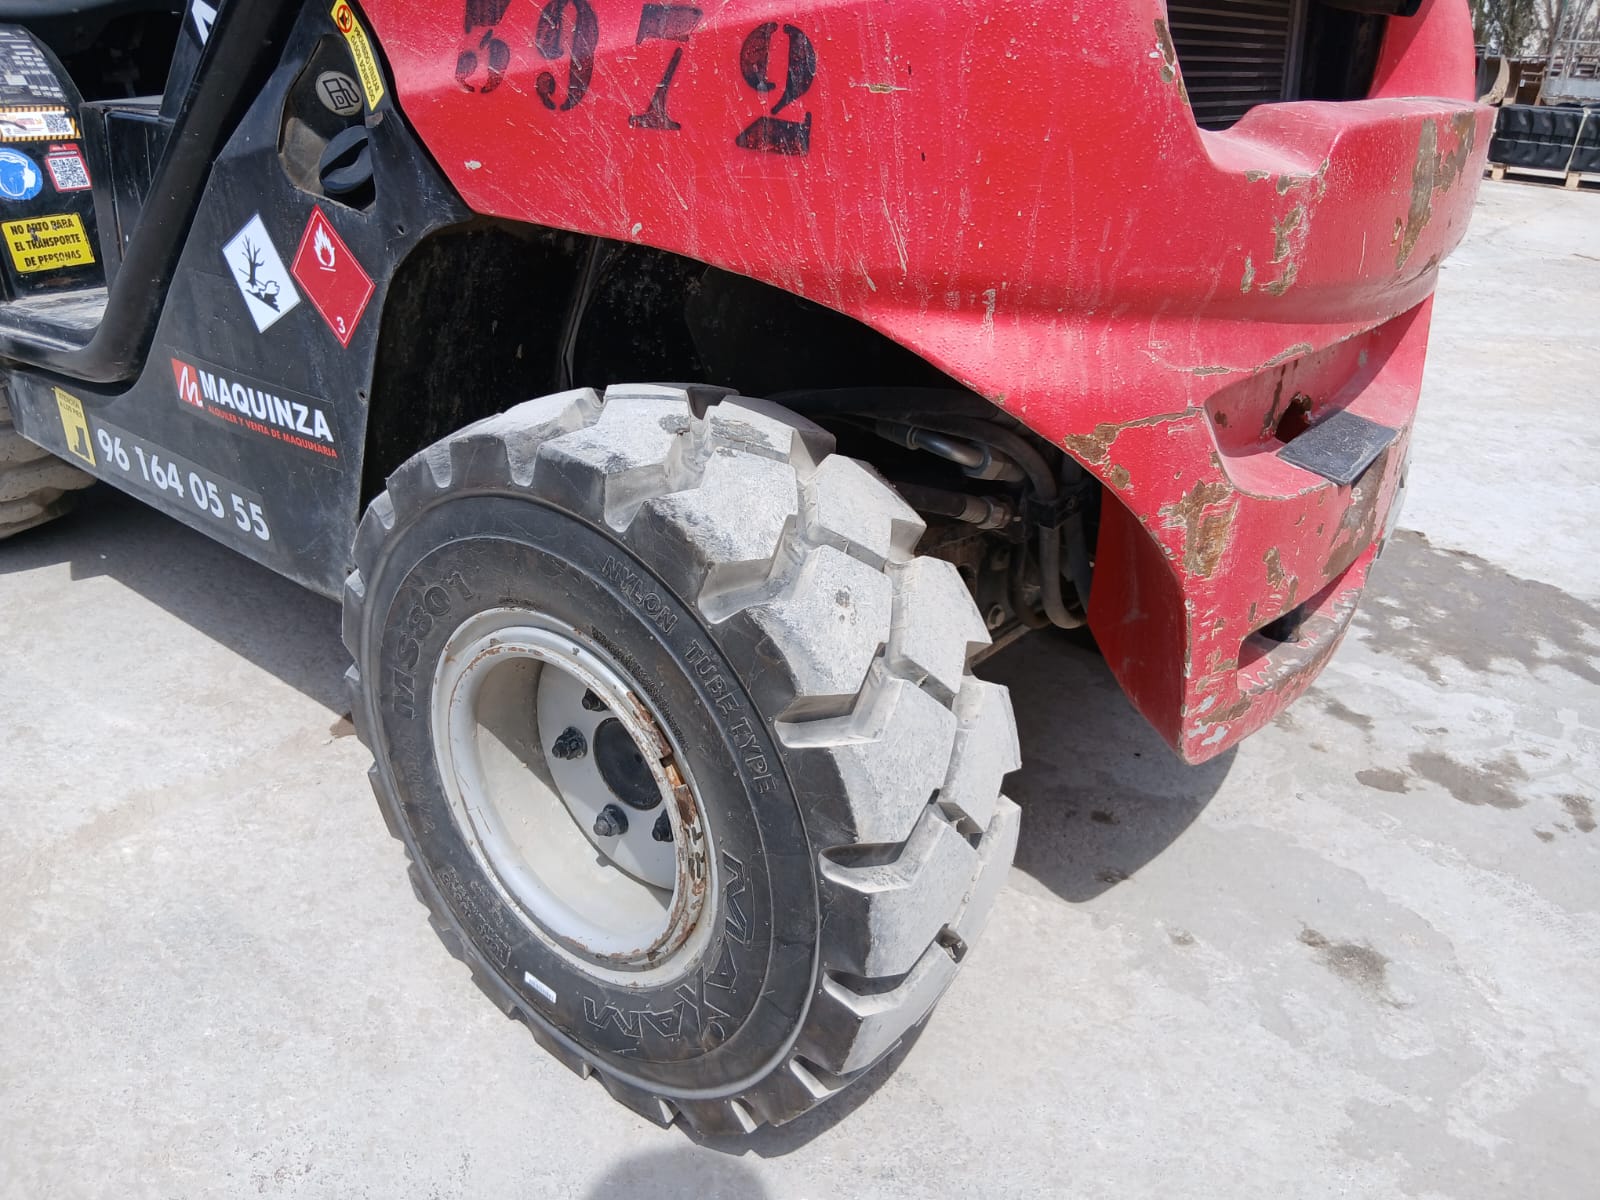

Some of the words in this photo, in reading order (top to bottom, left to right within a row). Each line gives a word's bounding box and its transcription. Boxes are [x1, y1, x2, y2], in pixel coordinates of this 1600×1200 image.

[10, 225, 25, 235] NO
[14, 242, 26, 252] EL
[26, 233, 81, 249] TRANSPORTE
[24, 256, 38, 267] DE
[38, 250, 81, 264] PERSONAS
[336, 316, 346, 334] 3
[199, 369, 334, 443] MAQUINZA
[207, 405, 239, 425] ALQUILER
[238, 418, 245, 426] Y
[245, 421, 271, 436] VENTA
[271, 428, 283, 440] DE
[282, 433, 338, 459] MAQUINARIA
[97, 428, 131, 471] 96
[133, 445, 185, 498] 164
[188, 471, 225, 519] 05
[230, 493, 270, 541] 55
[601, 556, 679, 634] NYLON
[684, 639, 740, 716] TUBE
[730, 716, 778, 794] TYPE
